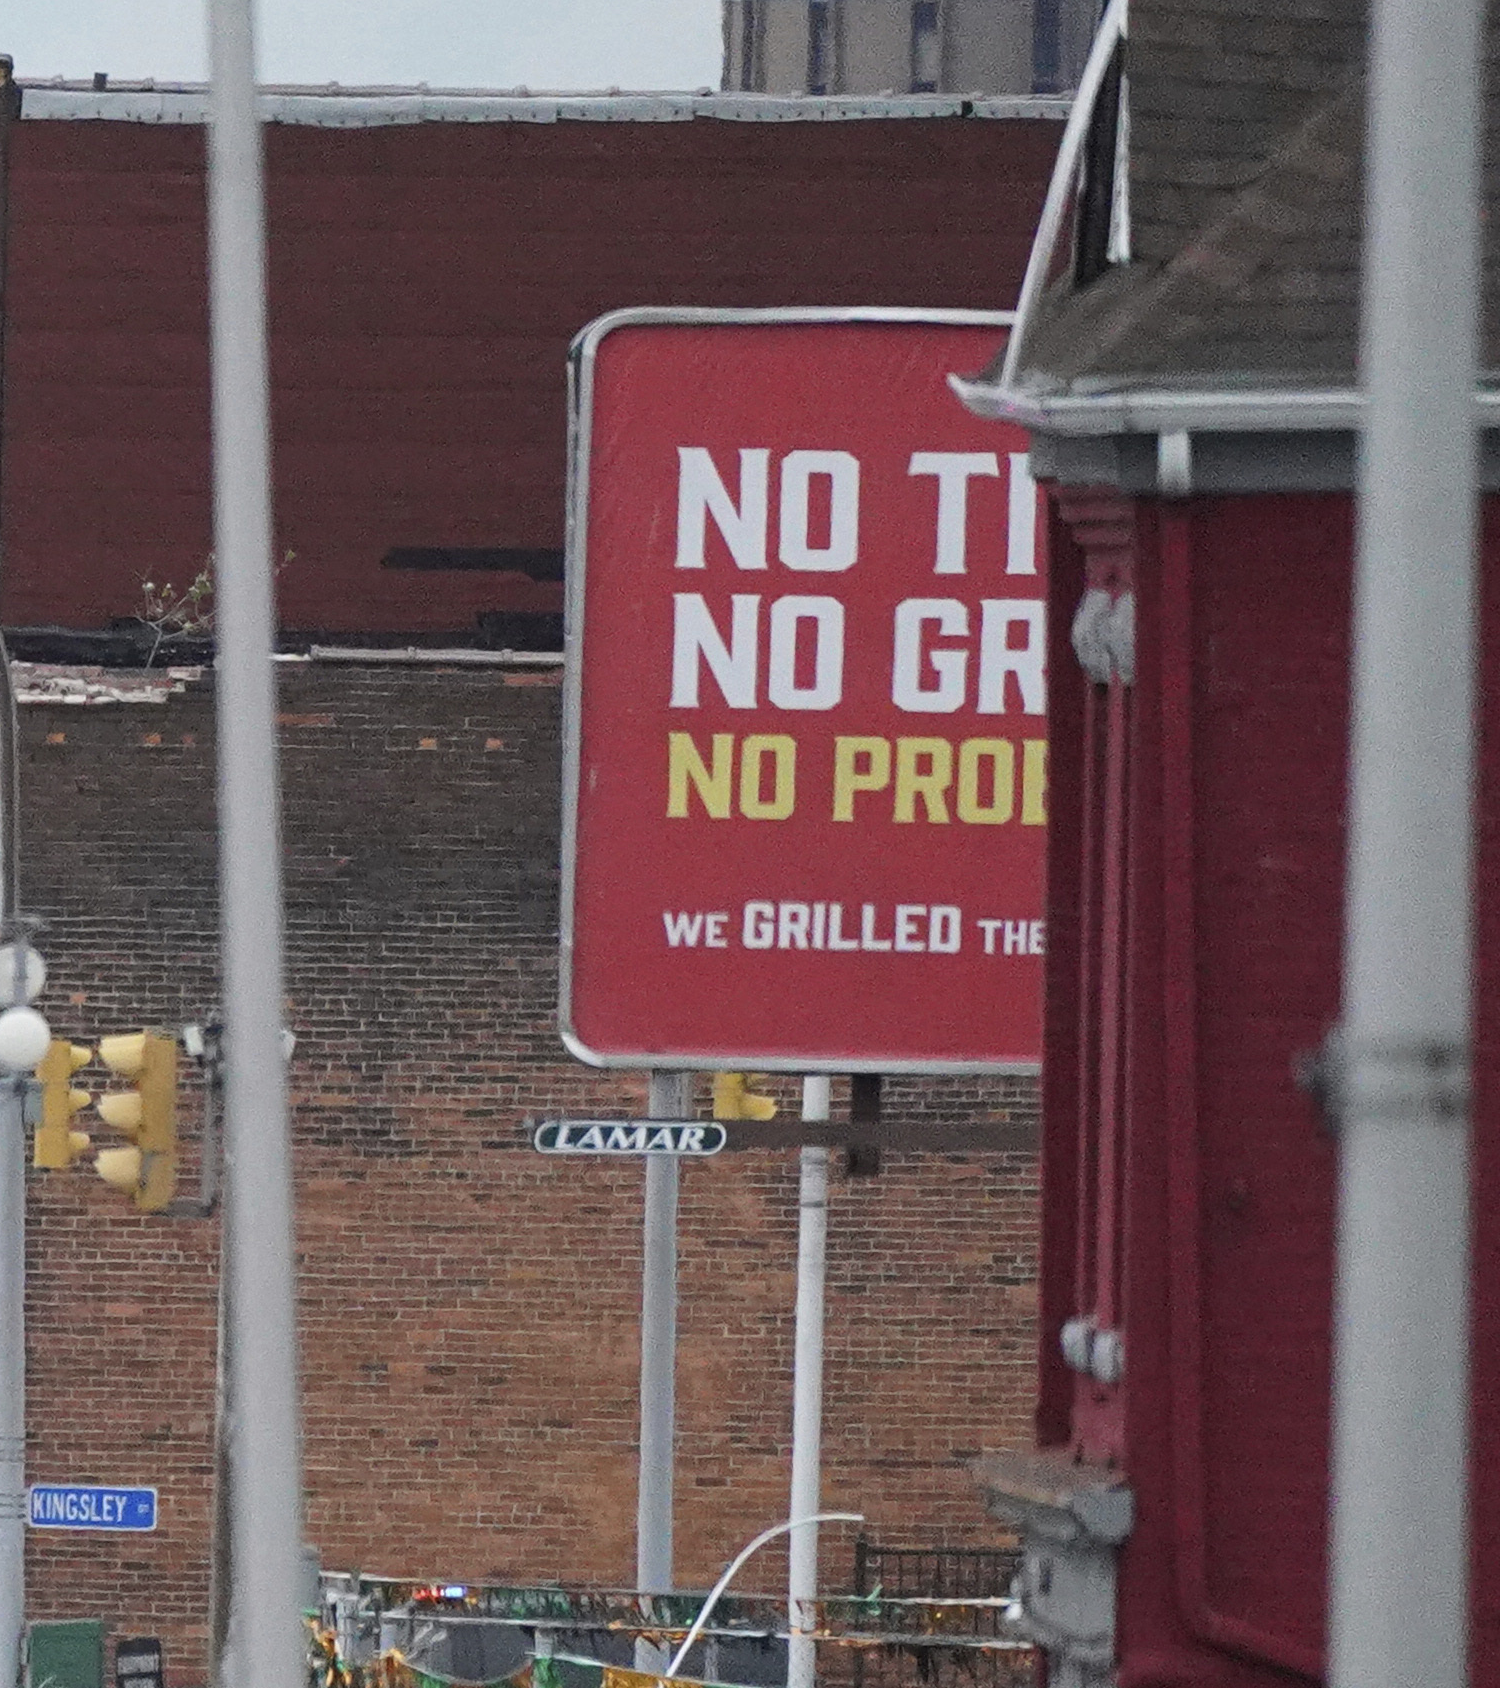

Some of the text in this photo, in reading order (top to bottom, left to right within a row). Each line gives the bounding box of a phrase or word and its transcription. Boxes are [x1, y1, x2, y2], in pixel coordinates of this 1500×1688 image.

[676, 447, 1037, 575] NO TI
[669, 594, 1047, 715] NO GR
[666, 733, 797, 821] NO
[663, 911, 729, 948] WE
[743, 899, 962, 954] GRILLED
[555, 1124, 707, 1151] LAMAR
[32, 1491, 127, 1523] KINGSLEY
